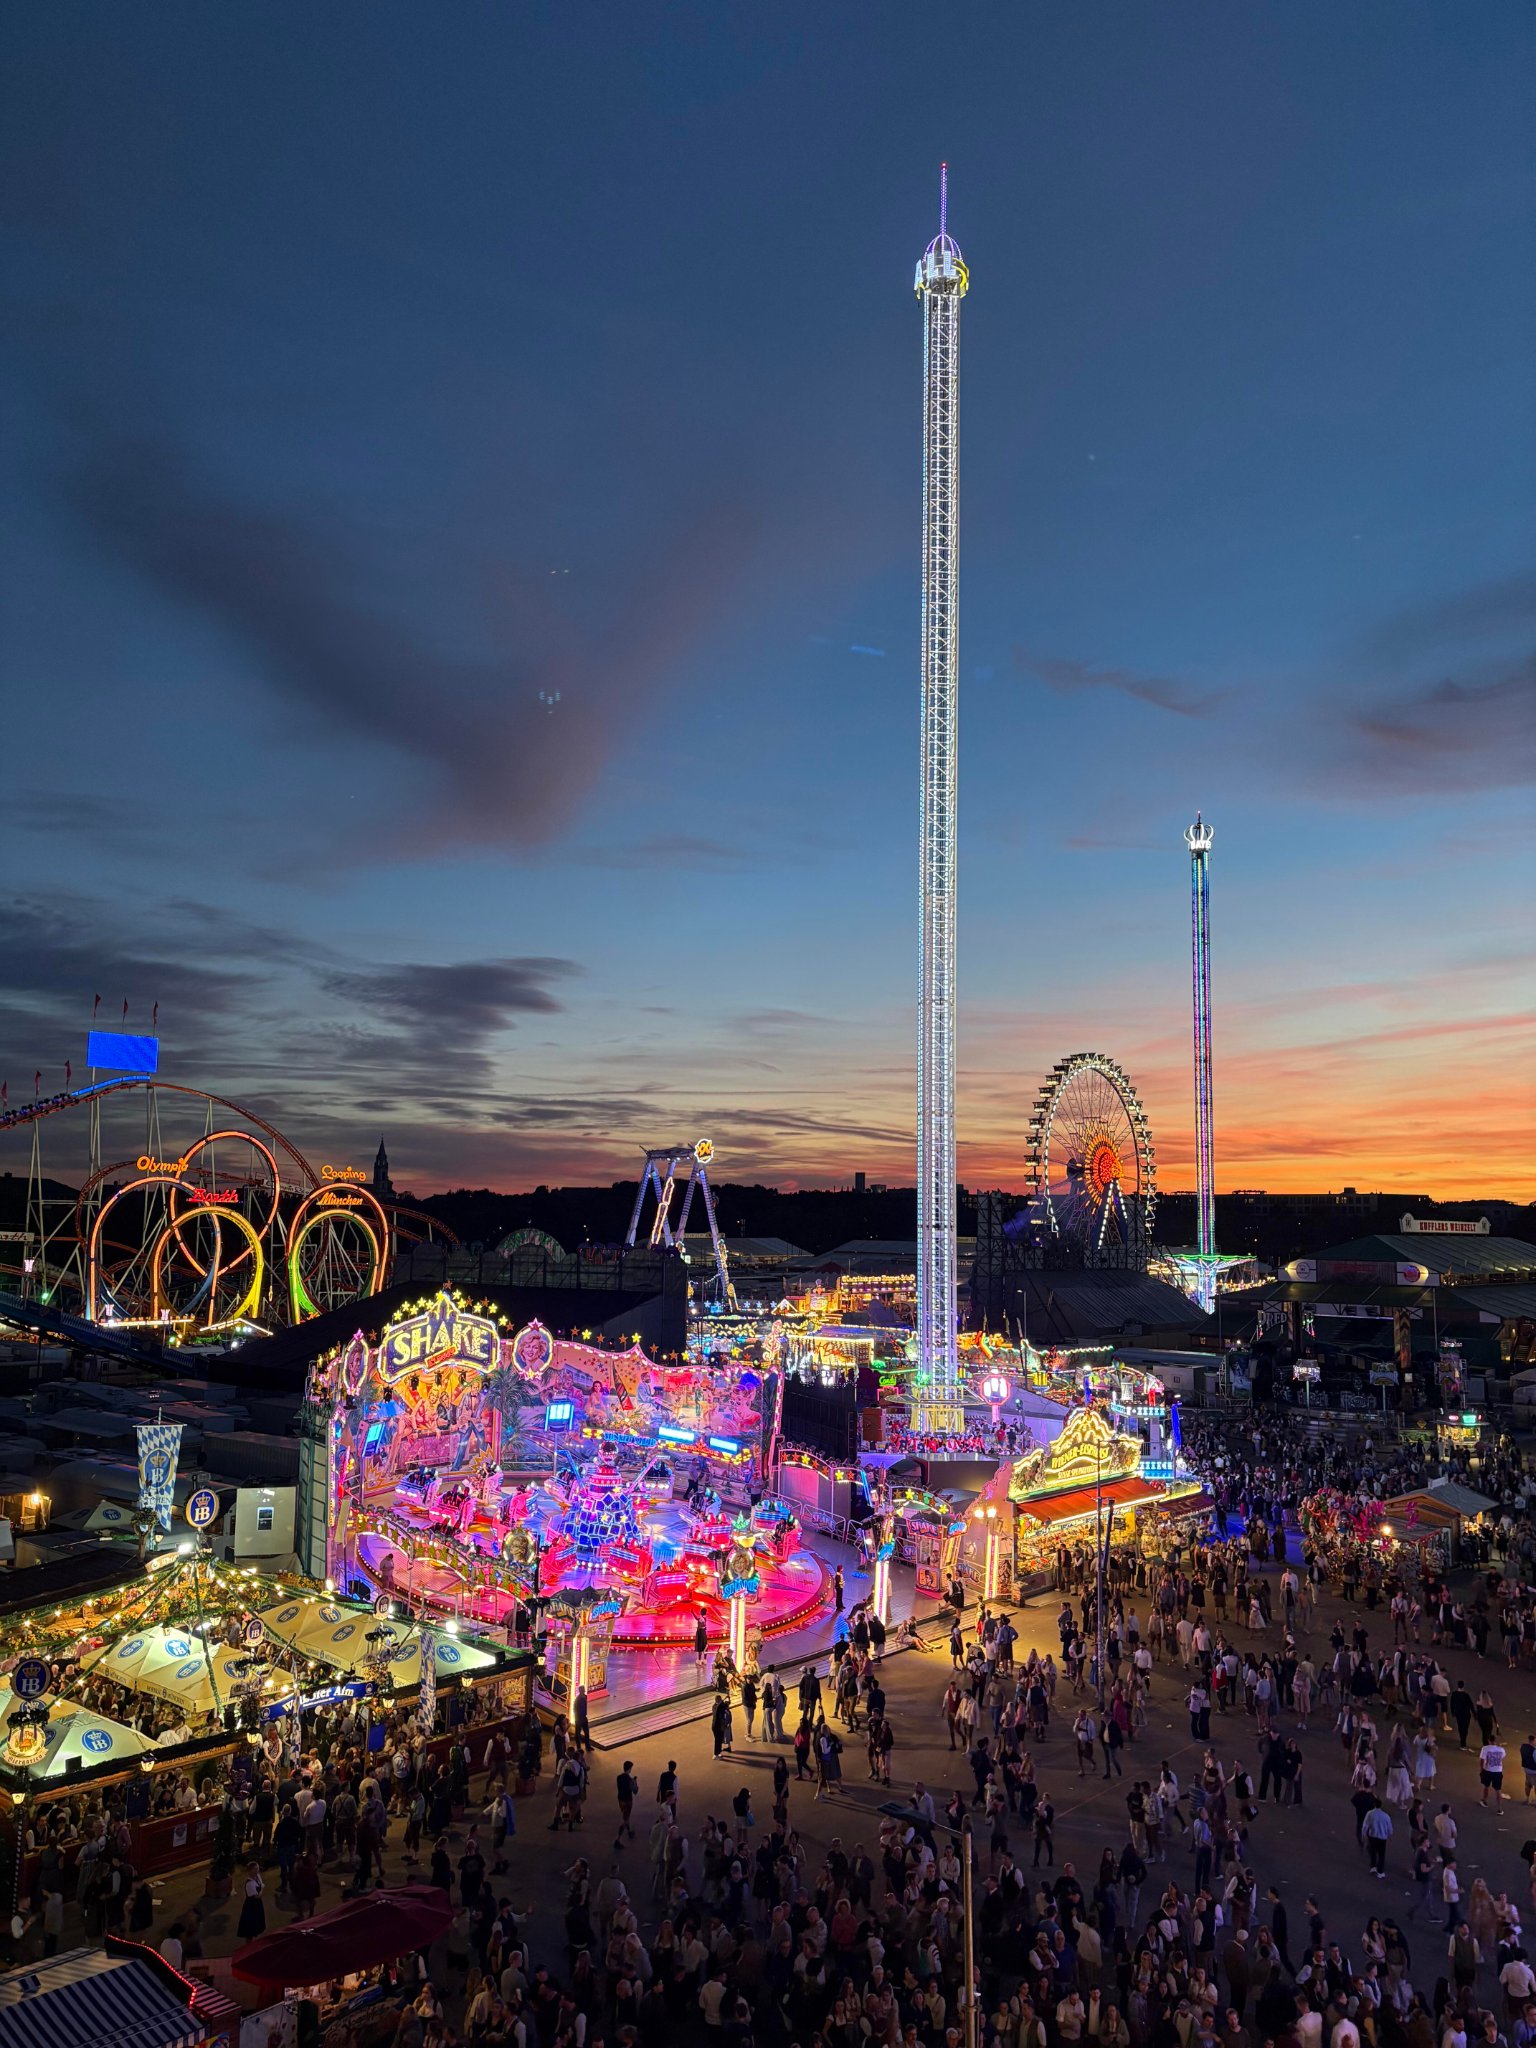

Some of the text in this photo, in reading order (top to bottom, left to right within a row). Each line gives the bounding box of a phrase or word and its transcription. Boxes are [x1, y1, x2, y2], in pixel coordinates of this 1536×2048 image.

[136, 1156, 189, 1173] Olympia
[321, 1165, 367, 1181] Looping
[316, 1192, 363, 1205] München
[1419, 1221, 1476, 1232] KUFFLERS WEINZELT
[392, 1321, 489, 1365] SHAKE
[194, 1507, 211, 1522] HB
[911, 1521, 938, 1536] SHAKE
[21, 1678, 41, 1693] HB
[333, 1685, 355, 1697] Alm
[91, 1737, 109, 1751] HB
